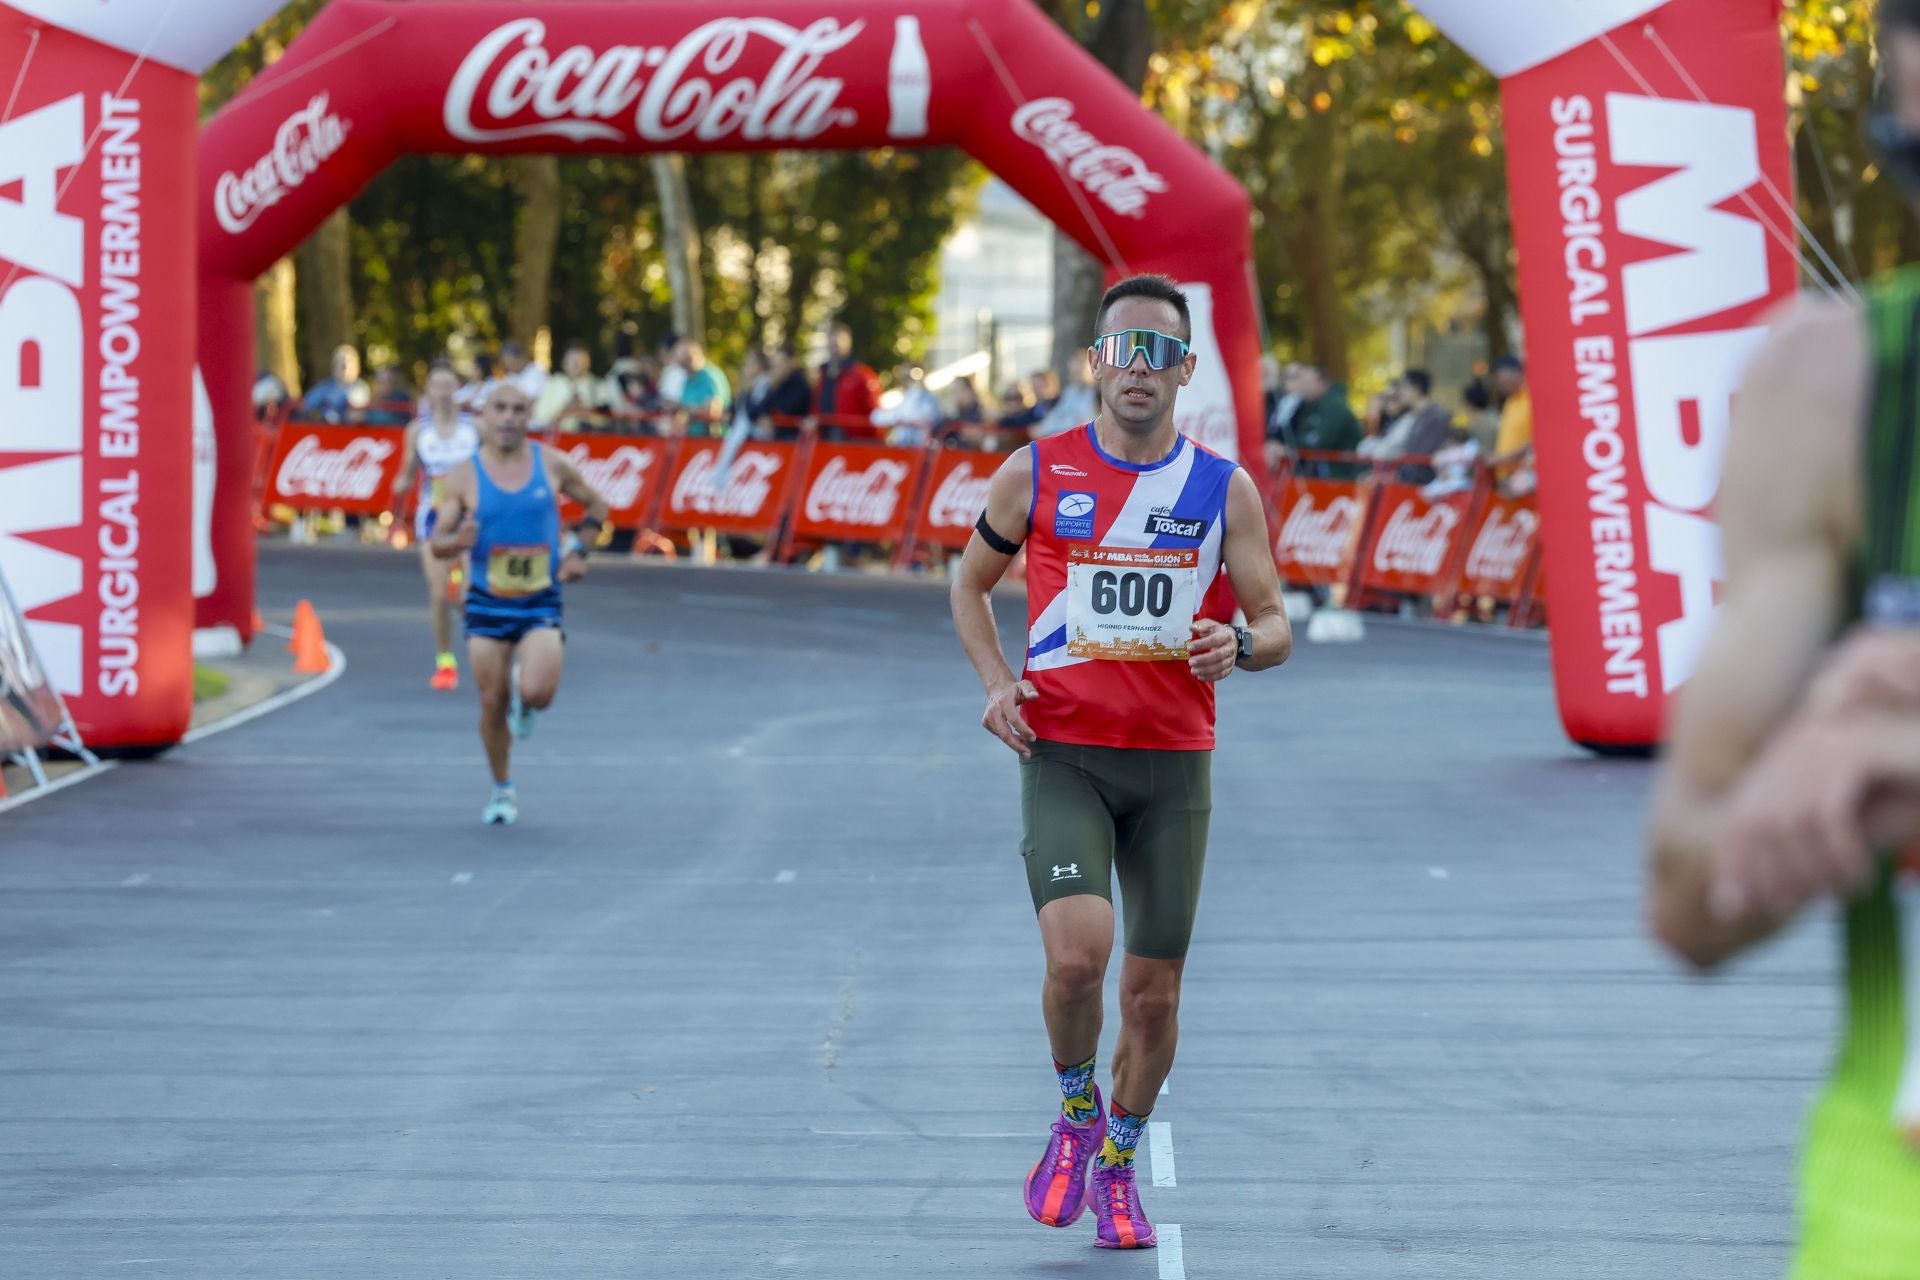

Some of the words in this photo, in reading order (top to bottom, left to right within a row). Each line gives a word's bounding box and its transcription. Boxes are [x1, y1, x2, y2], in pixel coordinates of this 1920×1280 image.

[443, 16, 867, 142] Coca-Cola
[213, 91, 349, 234] Coca-Cola
[1010, 96, 1169, 220] Coca-Cola
[1551, 94, 1610, 326] SURGICAL
[100, 91, 141, 457] EMPOWERMENT
[275, 434, 396, 499] Coca-Cola
[805, 455, 909, 525] Coca-Cola
[1055, 519, 1091, 528] DEPORTE
[1055, 527, 1092, 535] ASTURIANO
[1150, 505, 1172, 514] cafés
[1153, 517, 1201, 537] Toscaf
[1373, 500, 1459, 576] Coca-Cola
[1573, 335, 1648, 698] EMPOWERMENT
[98, 470, 140, 697] SURGICAL
[1107, 552, 1133, 562] MBA
[1154, 553, 1181, 564] GIJÓN
[1091, 570, 1173, 618] 600
[1097, 623, 1121, 631] HIGINIO
